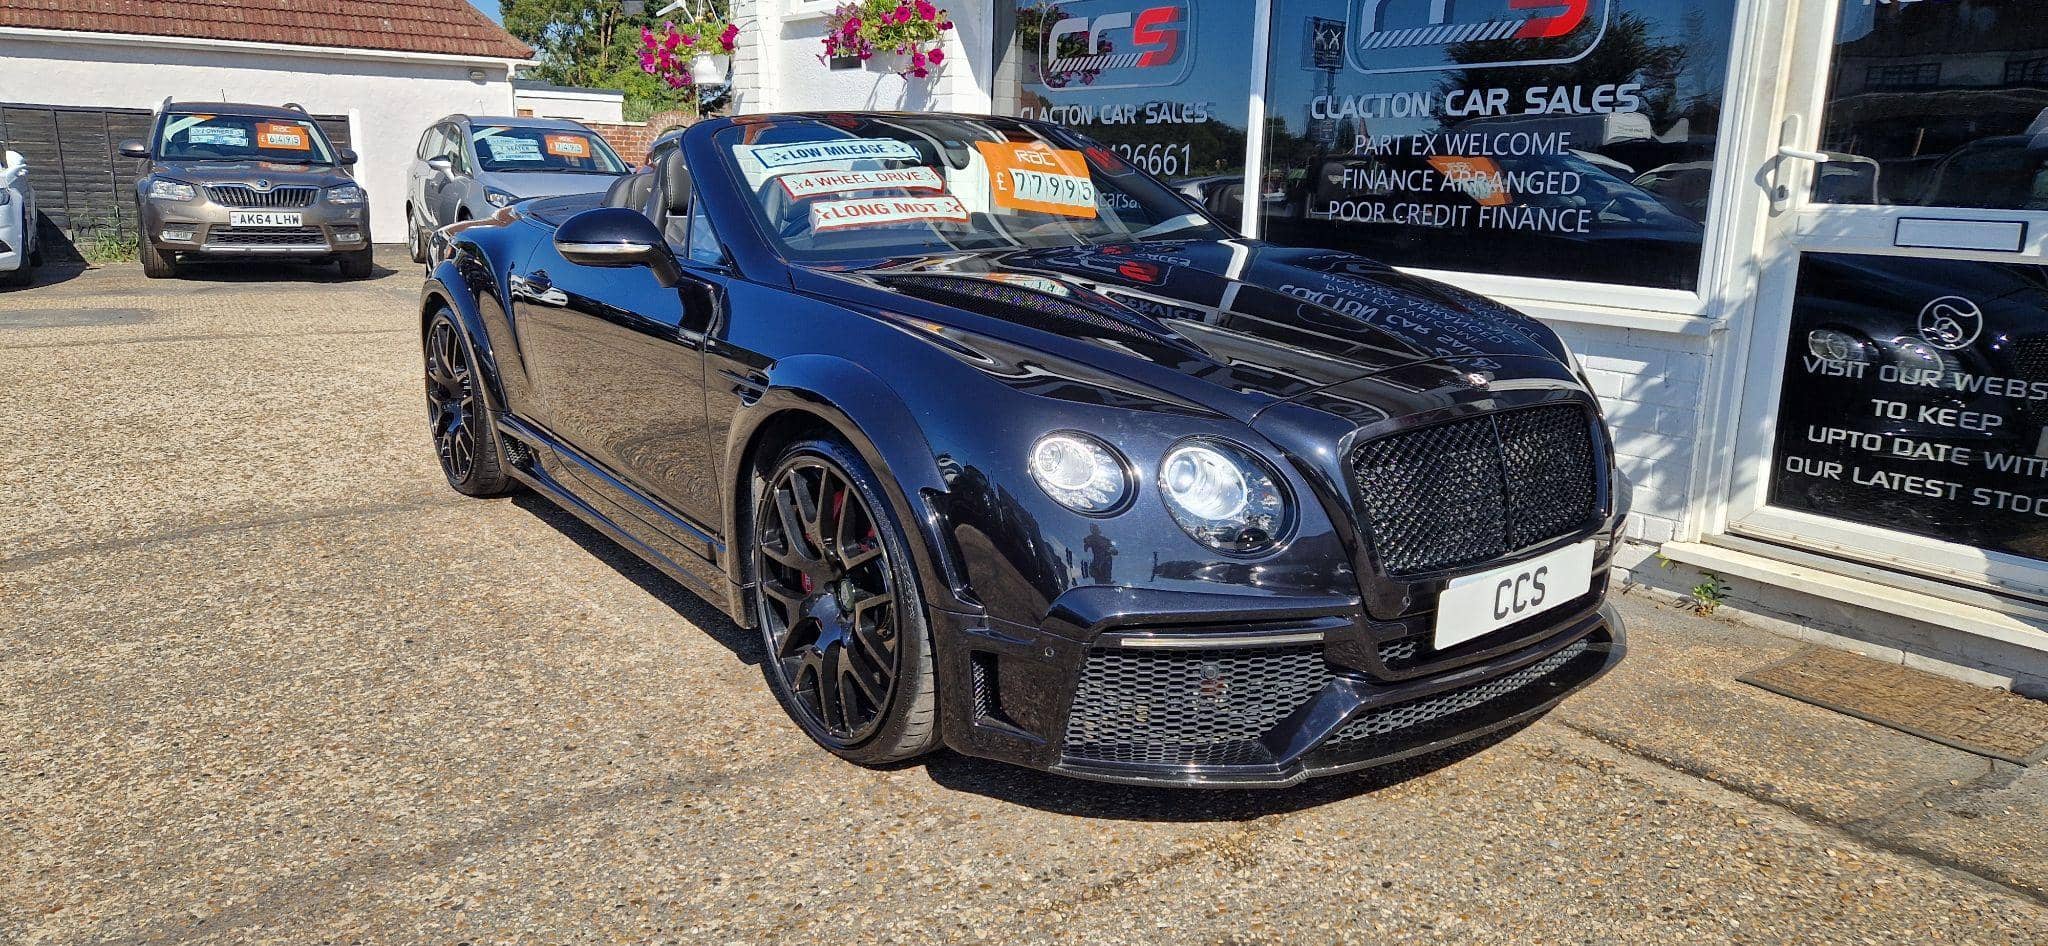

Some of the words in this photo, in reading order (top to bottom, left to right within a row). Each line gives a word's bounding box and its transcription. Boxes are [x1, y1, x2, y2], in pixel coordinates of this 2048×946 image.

[1048, 6, 1179, 72] CCS
[1020, 105, 1093, 126] CLACTON
[1101, 104, 1136, 125] CAR
[1145, 101, 1209, 125] SALES
[1311, 92, 1432, 119] CLACTON
[1445, 88, 1509, 116] CAR
[1525, 84, 1641, 115] SALES
[788, 149, 820, 159] LOW
[824, 144, 887, 156] MILEAGE
[1014, 149, 1056, 167] RAC
[1353, 134, 1401, 156] PART
[1411, 133, 1440, 156] EX
[1446, 131, 1571, 156] WELCOME
[804, 178, 814, 188] 4
[815, 173, 876, 187] WHEEL
[878, 171, 923, 182] DRIVE
[996, 172, 1008, 191] £
[1014, 172, 1092, 201] 77995
[1342, 168, 1434, 192] FINANCE
[1440, 171, 1581, 195] ARRANGED
[240, 214, 271, 224] AK64
[275, 214, 299, 224] LHW
[830, 203, 890, 219] LONG
[894, 203, 938, 214] MOT
[1328, 200, 1386, 223] POOR
[1392, 202, 1472, 228] CREDIT
[1478, 206, 1592, 234] FINANCE
[1803, 355, 1870, 379] VISIT
[1879, 364, 1941, 388] OUR
[1871, 398, 1907, 420] TO
[1917, 405, 2003, 431] KEEP
[1808, 424, 1882, 452] UPTO
[1892, 437, 1972, 466] DATE
[1786, 456, 1843, 481] OUR
[1852, 466, 1963, 501] LATEST
[1493, 565, 1548, 621] CCS
